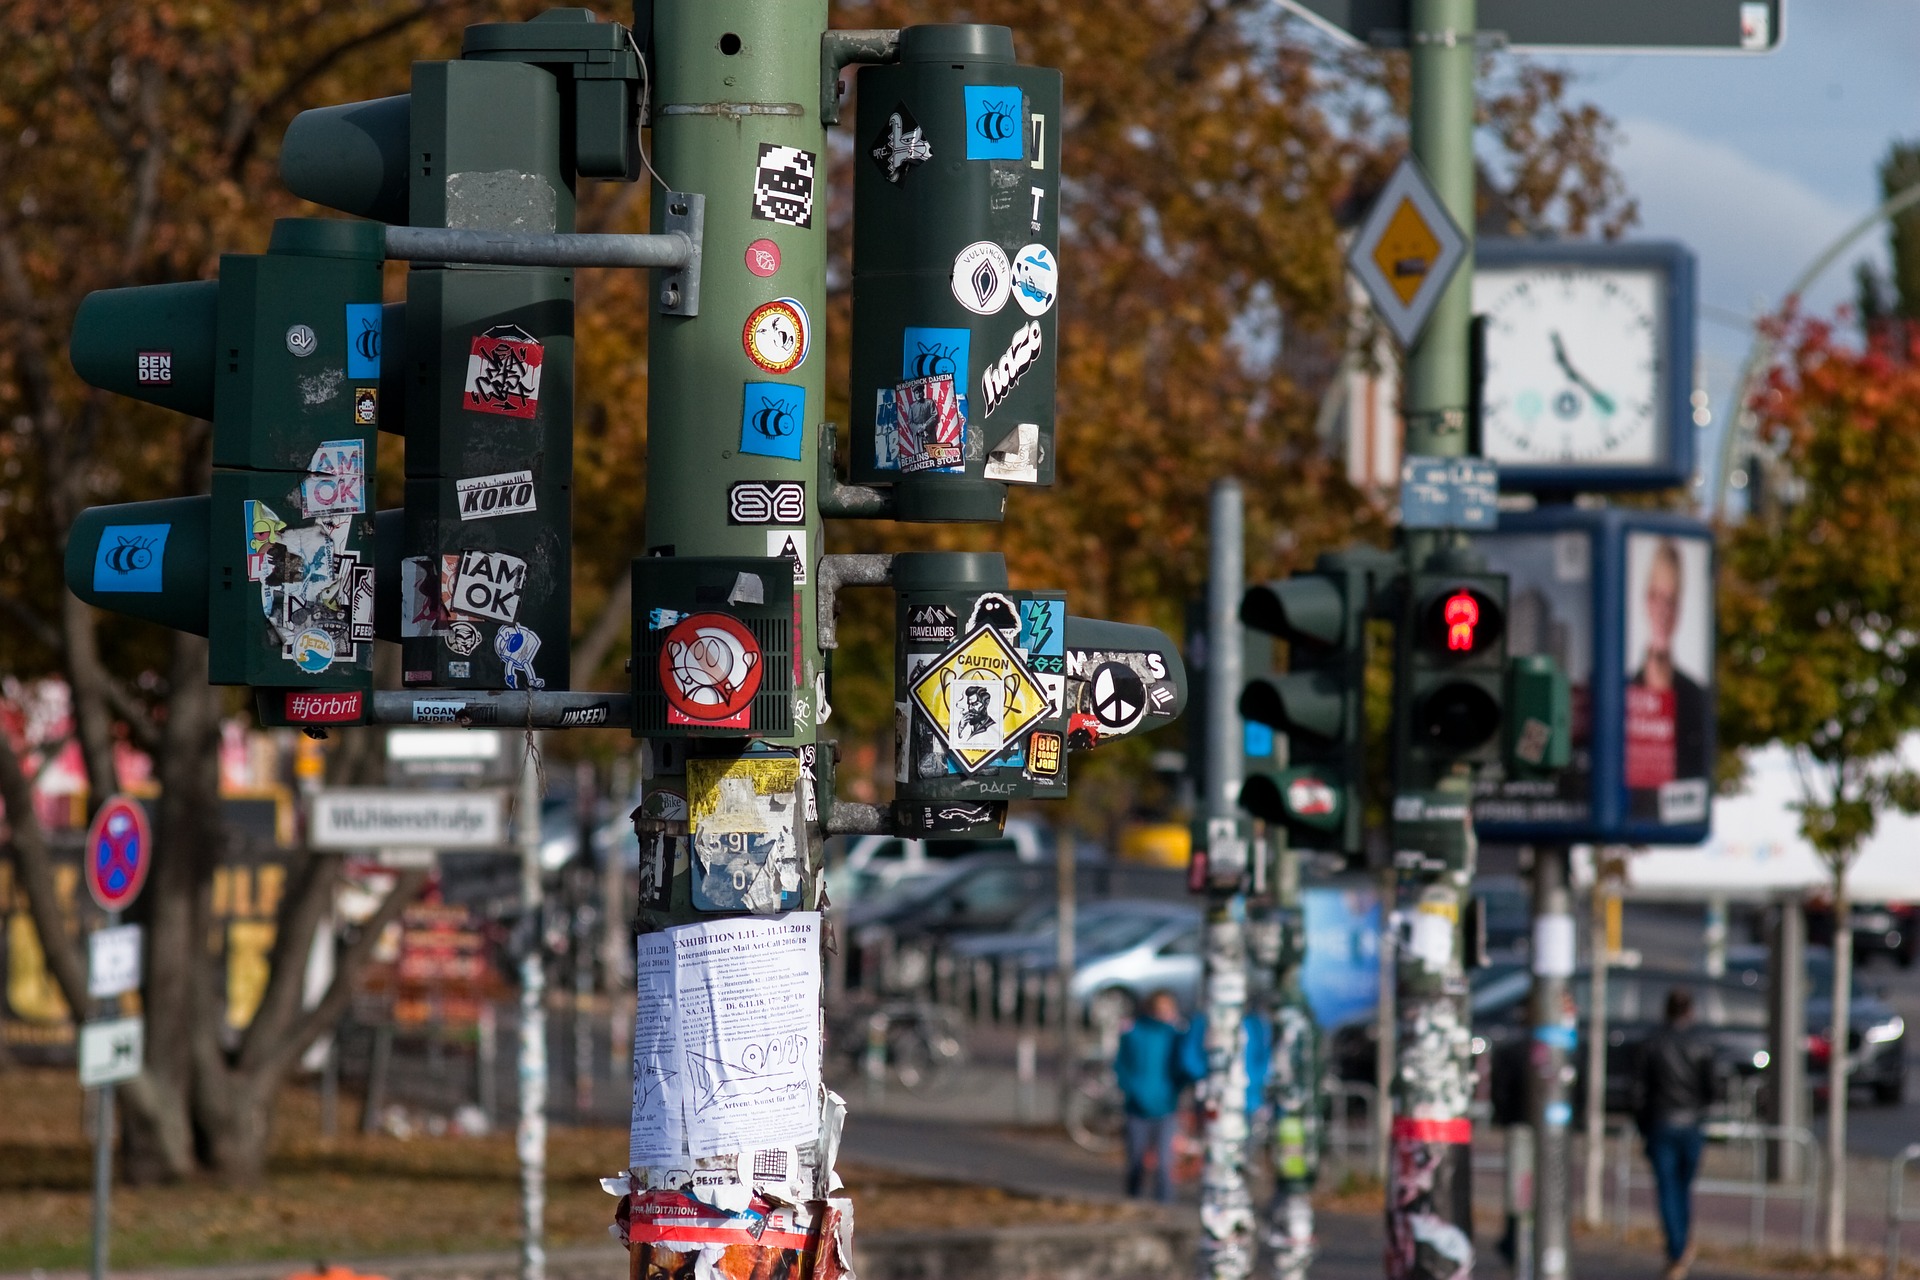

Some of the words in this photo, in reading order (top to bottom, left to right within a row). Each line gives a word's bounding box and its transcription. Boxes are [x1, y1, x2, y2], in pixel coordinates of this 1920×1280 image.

[138, 356, 171, 368] BEN
[138, 369, 171, 381] DEG
[928, 374, 953, 382] DAHEIM
[901, 451, 930, 467] BERLINS
[909, 459, 935, 472] GANZER
[936, 455, 962, 468] STOLZ
[463, 483, 533, 513] KOKO
[465, 583, 511, 617] OK
[909, 626, 955, 637] TRAVELVIBES
[957, 654, 1010, 670] CAUTION
[292, 695, 357, 718] #jörbrit
[416, 706, 456, 715] LOGAN
[562, 708, 606, 725] UNSEEN
[1038, 738, 1058, 751] BIG
[673, 932, 735, 950] EXHIBITION
[738, 929, 759, 939] 1.11.
[767, 925, 811, 936] 11.11.2018
[677, 946, 731, 960] Internationaler
[733, 943, 750, 952] Mail
[695, 1176, 724, 1185] BESTE
[645, 1203, 698, 1215] MEDITATION:
